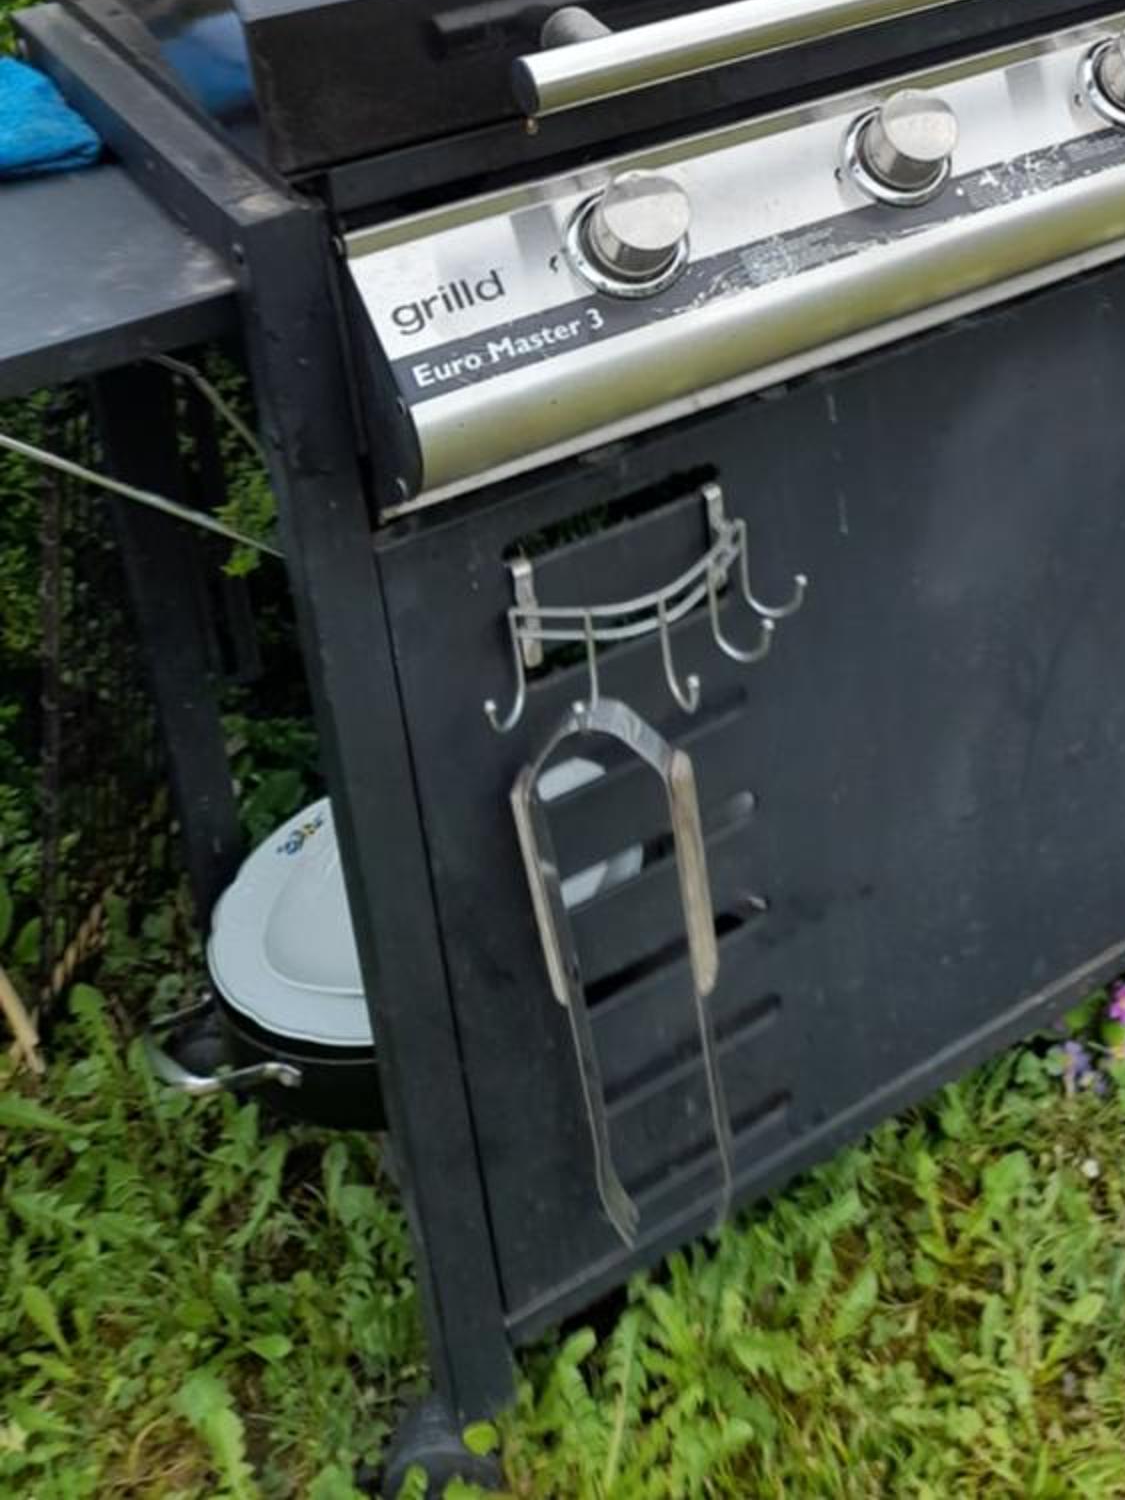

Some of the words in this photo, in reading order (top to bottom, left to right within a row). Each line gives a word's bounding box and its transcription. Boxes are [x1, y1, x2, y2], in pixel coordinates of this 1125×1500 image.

[391, 269, 505, 335] grilld
[412, 352, 482, 387] Euro
[486, 317, 582, 364] Master
[585, 307, 605, 330] 3
